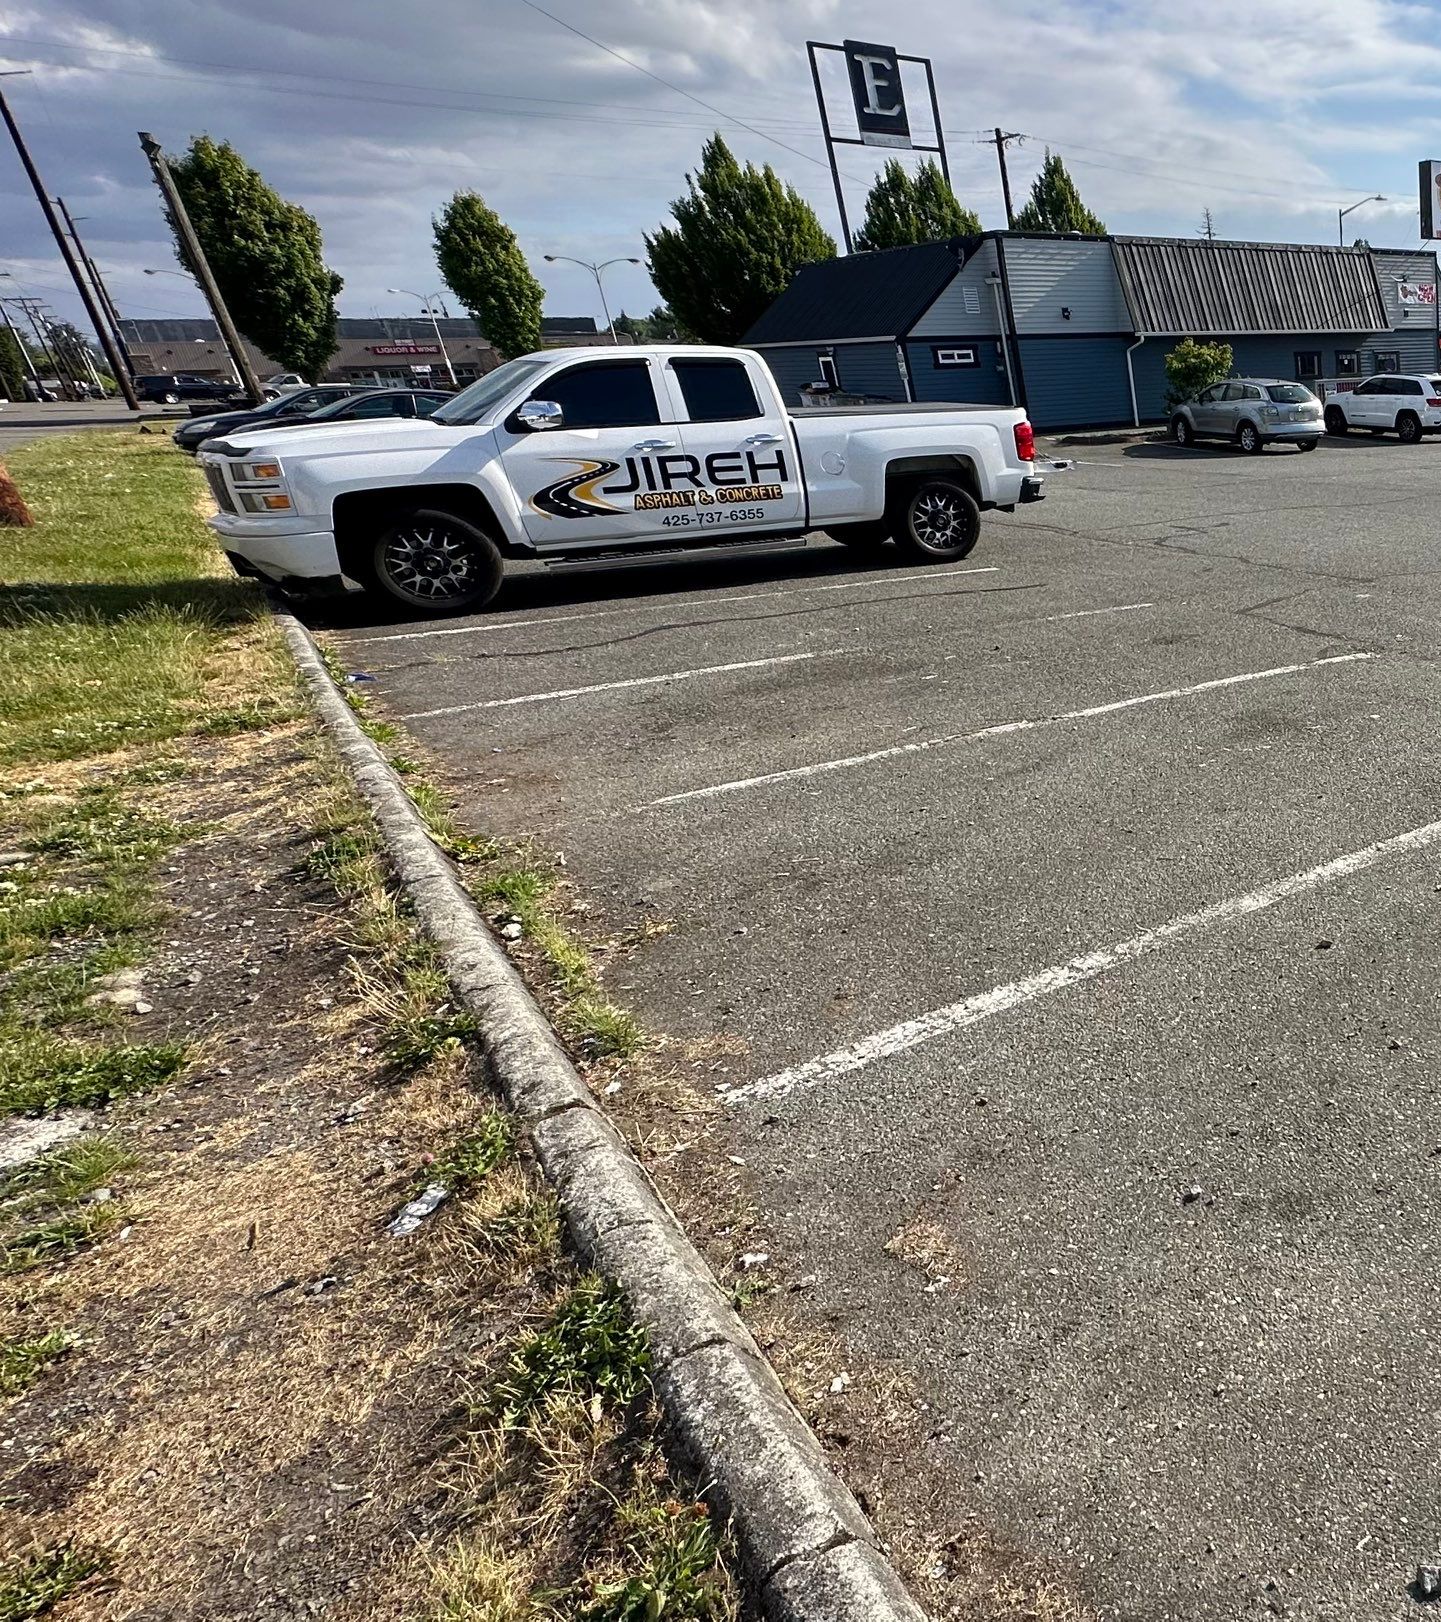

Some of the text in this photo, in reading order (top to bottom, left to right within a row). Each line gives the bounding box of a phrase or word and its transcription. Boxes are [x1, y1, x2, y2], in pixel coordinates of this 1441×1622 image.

[854, 54, 900, 116] E
[602, 450, 788, 494] JIREH
[634, 484, 783, 511] ASPHALT & CONCRETE
[662, 508, 765, 527] 425-737-6355
